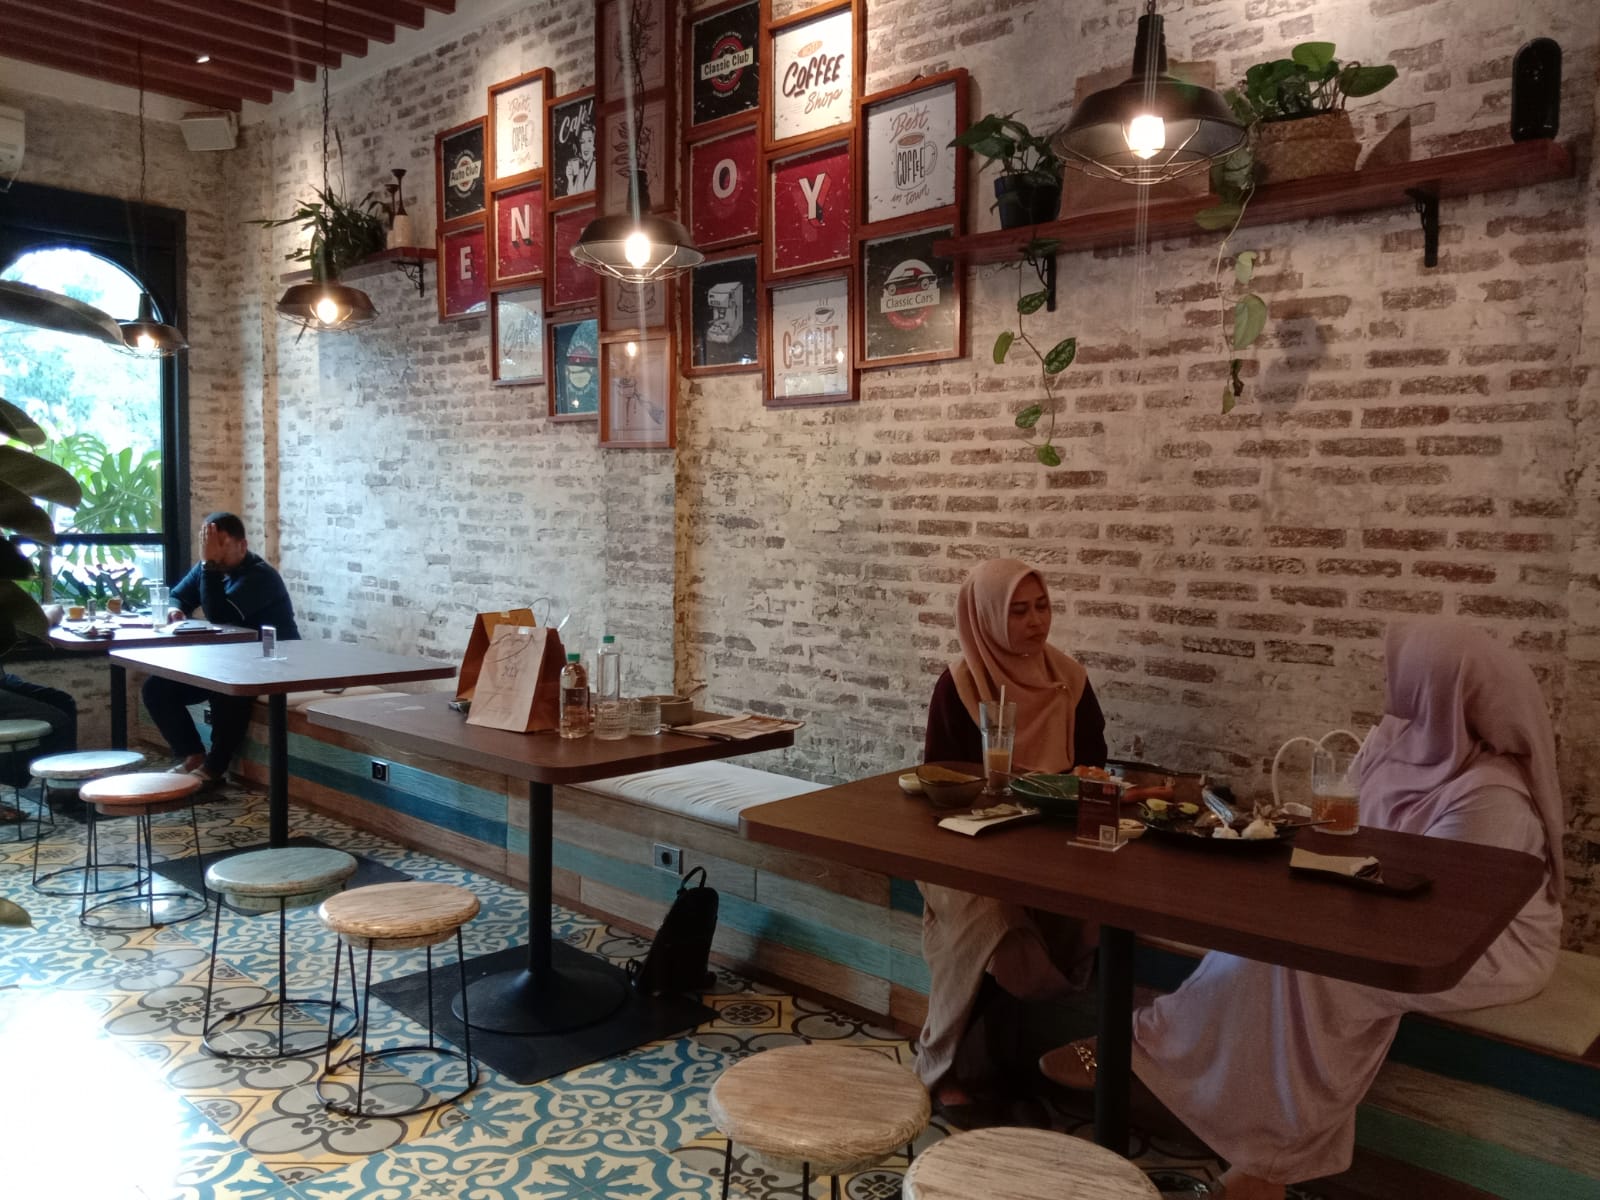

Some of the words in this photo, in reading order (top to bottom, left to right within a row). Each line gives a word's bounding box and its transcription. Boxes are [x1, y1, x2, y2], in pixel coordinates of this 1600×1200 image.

[704, 58, 730, 76] Classic
[732, 51, 750, 66] Club
[804, 89, 843, 115] Shop
[889, 104, 930, 144] Best
[712, 158, 737, 199] O
[897, 147, 925, 186] COFFEE
[799, 172, 826, 220] Y
[510, 204, 530, 242] N
[460, 245, 472, 280] E
[886, 296, 913, 309] Classic
[915, 293, 934, 305] Cars
